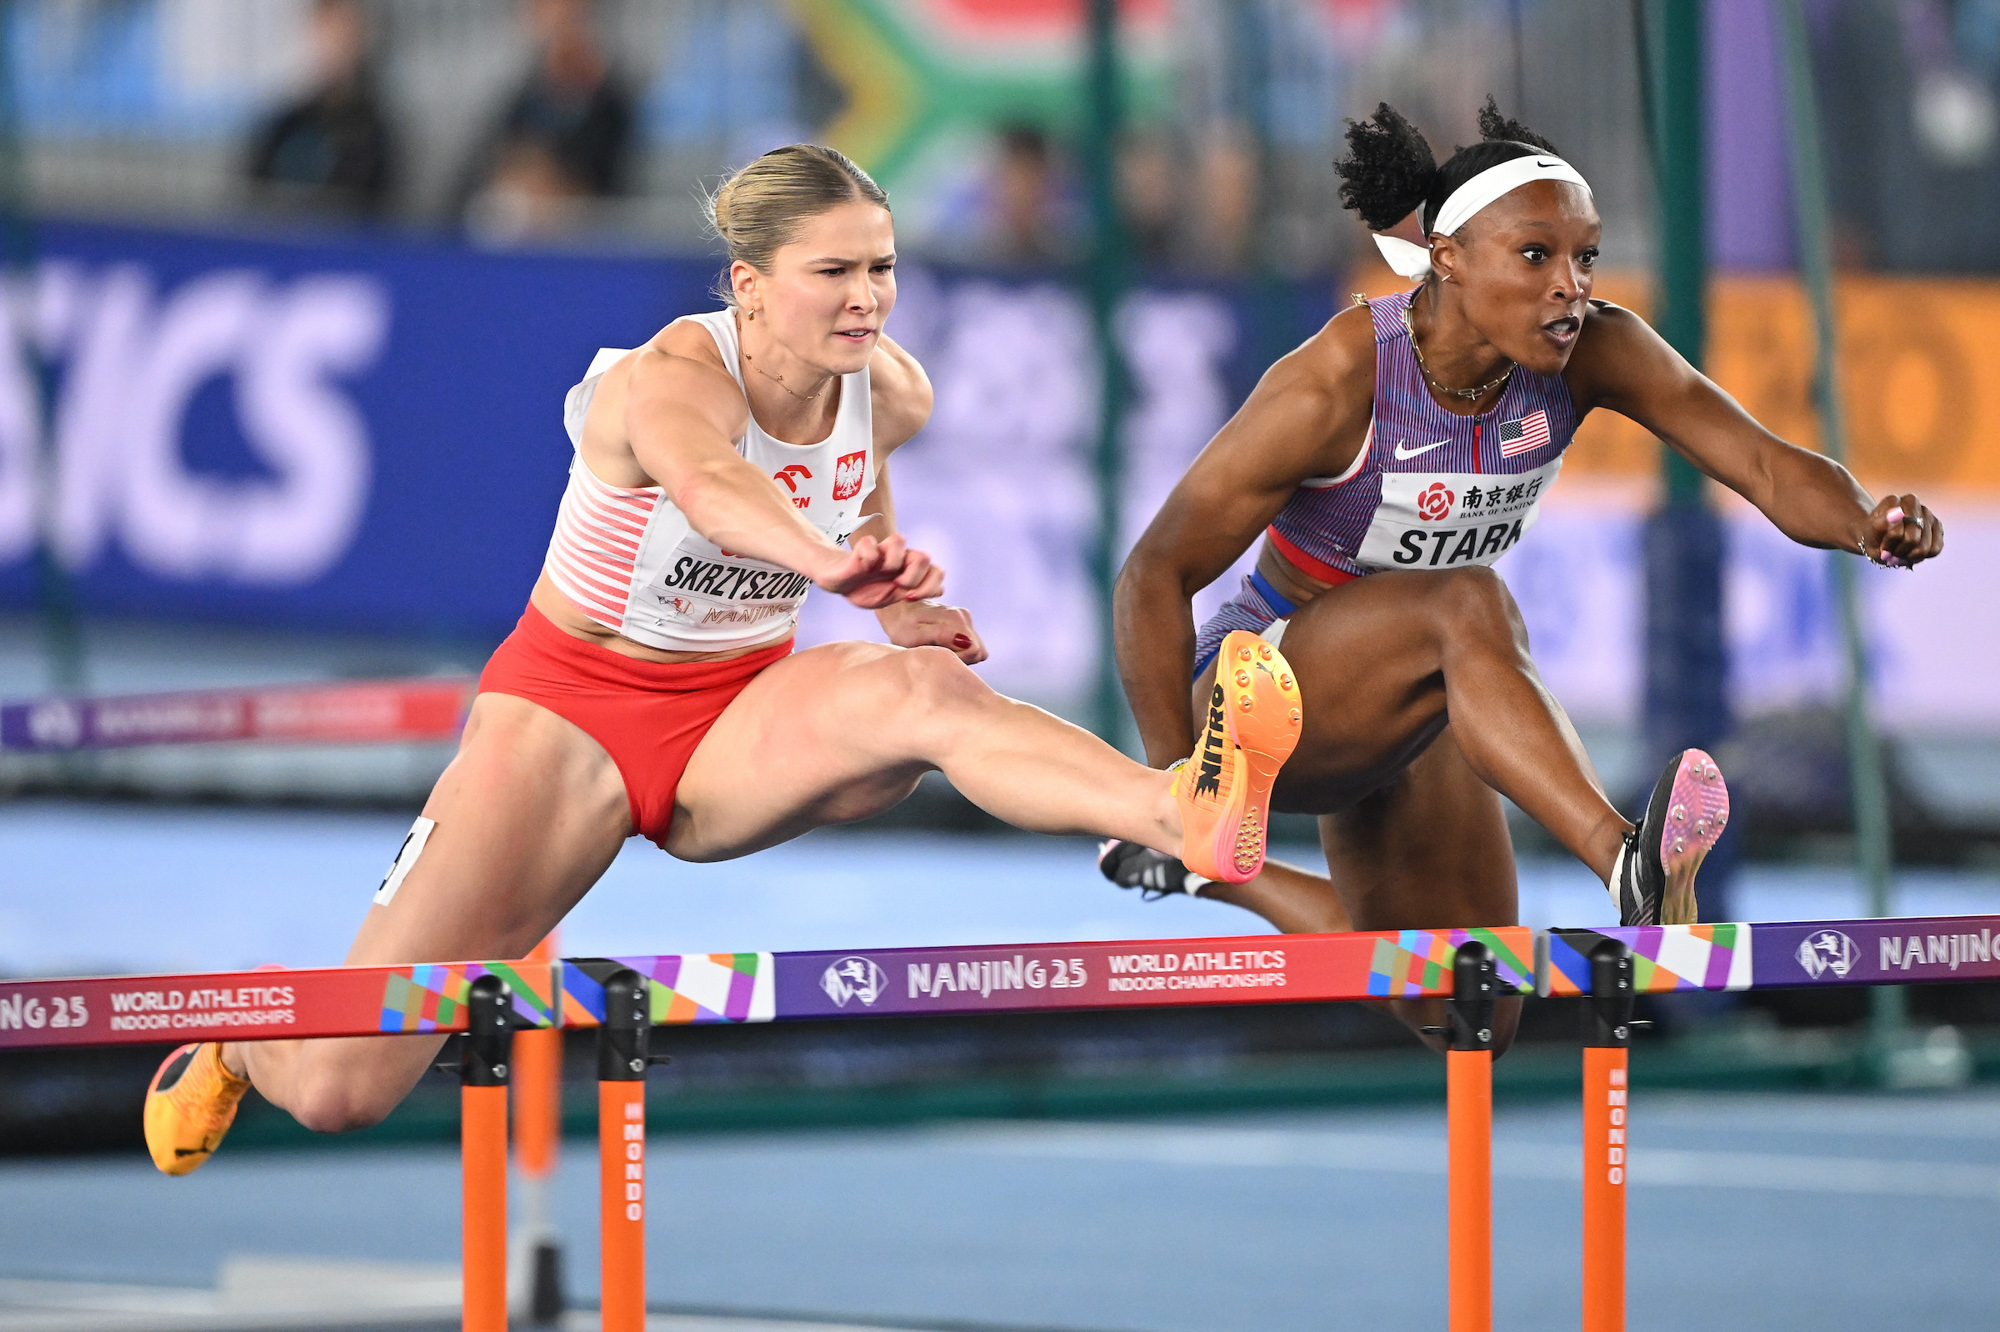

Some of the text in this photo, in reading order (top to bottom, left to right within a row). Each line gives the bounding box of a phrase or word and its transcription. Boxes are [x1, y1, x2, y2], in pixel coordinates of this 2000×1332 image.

[1459, 509, 1486, 519] BANK
[1487, 508, 1500, 516] OF
[1193, 683, 1225, 800] NITRO
[906, 955, 1088, 998] NANJING 25
[1108, 950, 1286, 974] WORLD ATHLETICS
[1108, 973, 1287, 992] INDOOR CHAMPIONSHIPS
[0, 993, 89, 1029] NG 25
[110, 986, 295, 1012] WORLD ATHLETICS
[110, 1009, 296, 1031] INDOOR CHAMPIONSHIPS
[1607, 1089, 1626, 1185] MONDO
[624, 1124, 643, 1221] MONDO
